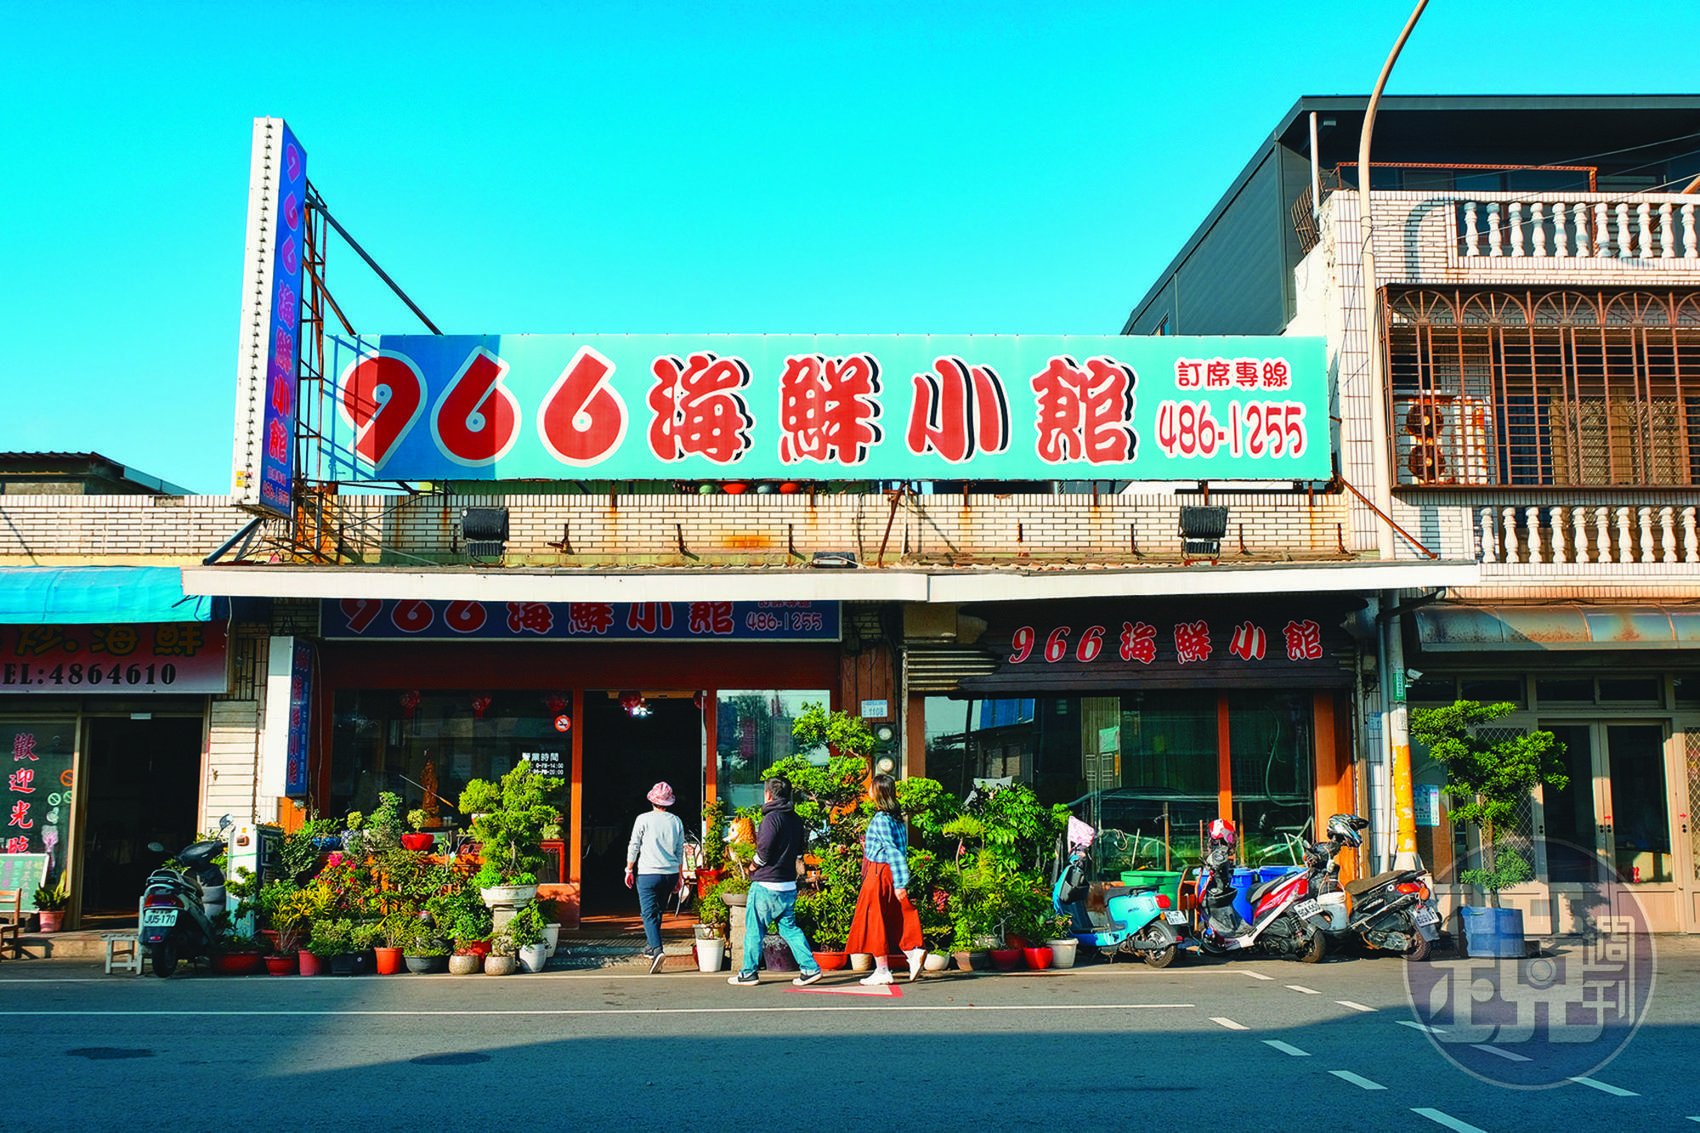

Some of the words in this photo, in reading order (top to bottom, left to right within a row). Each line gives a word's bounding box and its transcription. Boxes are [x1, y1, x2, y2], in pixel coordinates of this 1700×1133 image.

[1175, 357, 1292, 391] 訂席專線
[336, 345, 1139, 468] 966海鮮小館
[1155, 400, 1306, 459] 486-1255
[745, 611, 823, 632] 486-1255
[1008, 619, 1324, 664] 966海鮮小館
[8, 733, 39, 854] 歡迎光臨
